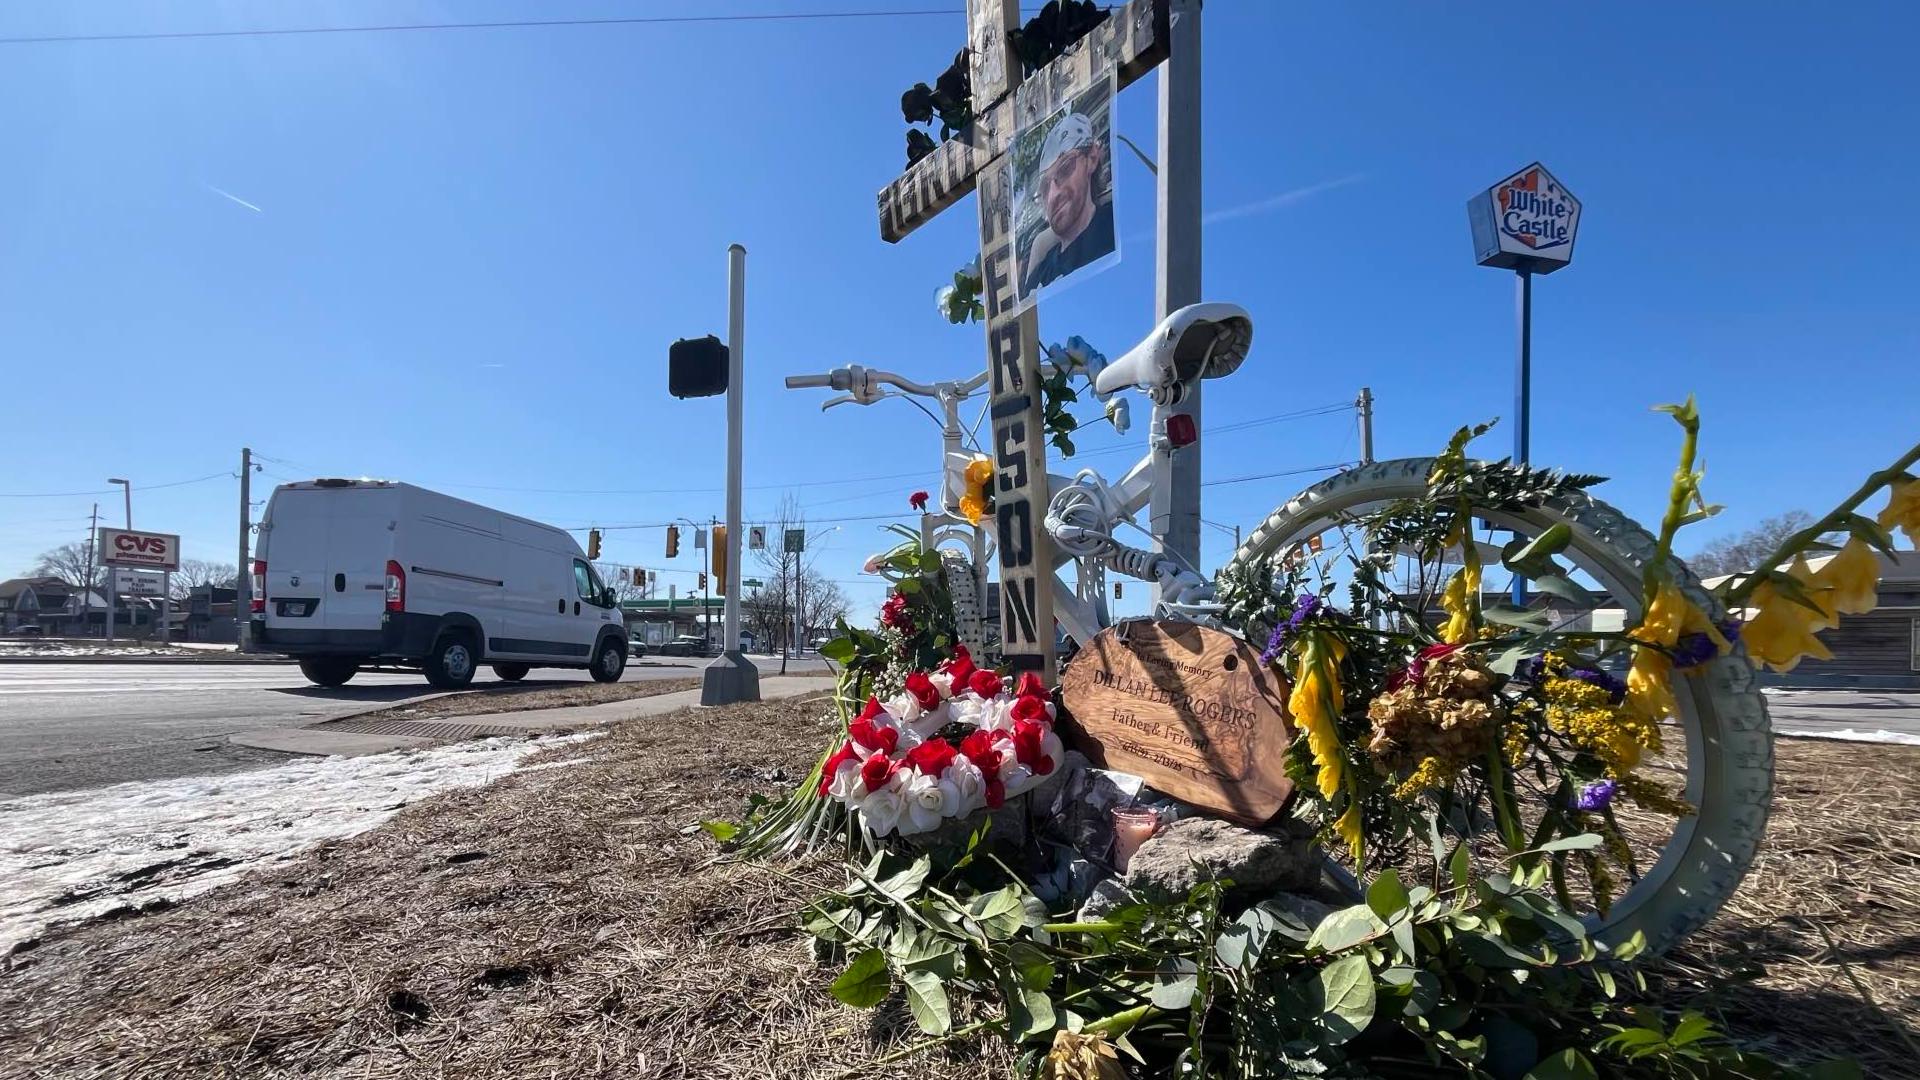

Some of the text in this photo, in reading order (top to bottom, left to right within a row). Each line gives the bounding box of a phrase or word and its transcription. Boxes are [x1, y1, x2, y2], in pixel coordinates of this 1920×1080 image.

[1508, 189, 1566, 218] White
[1503, 211, 1568, 241] Castle
[114, 534, 166, 554] CVS
[115, 551, 166, 562] pharmacy
[1176, 661, 1214, 680] Memory
[1093, 669, 1257, 730] DILLAN LEE ROGERS
[1112, 708, 1209, 753] Father & Friend
